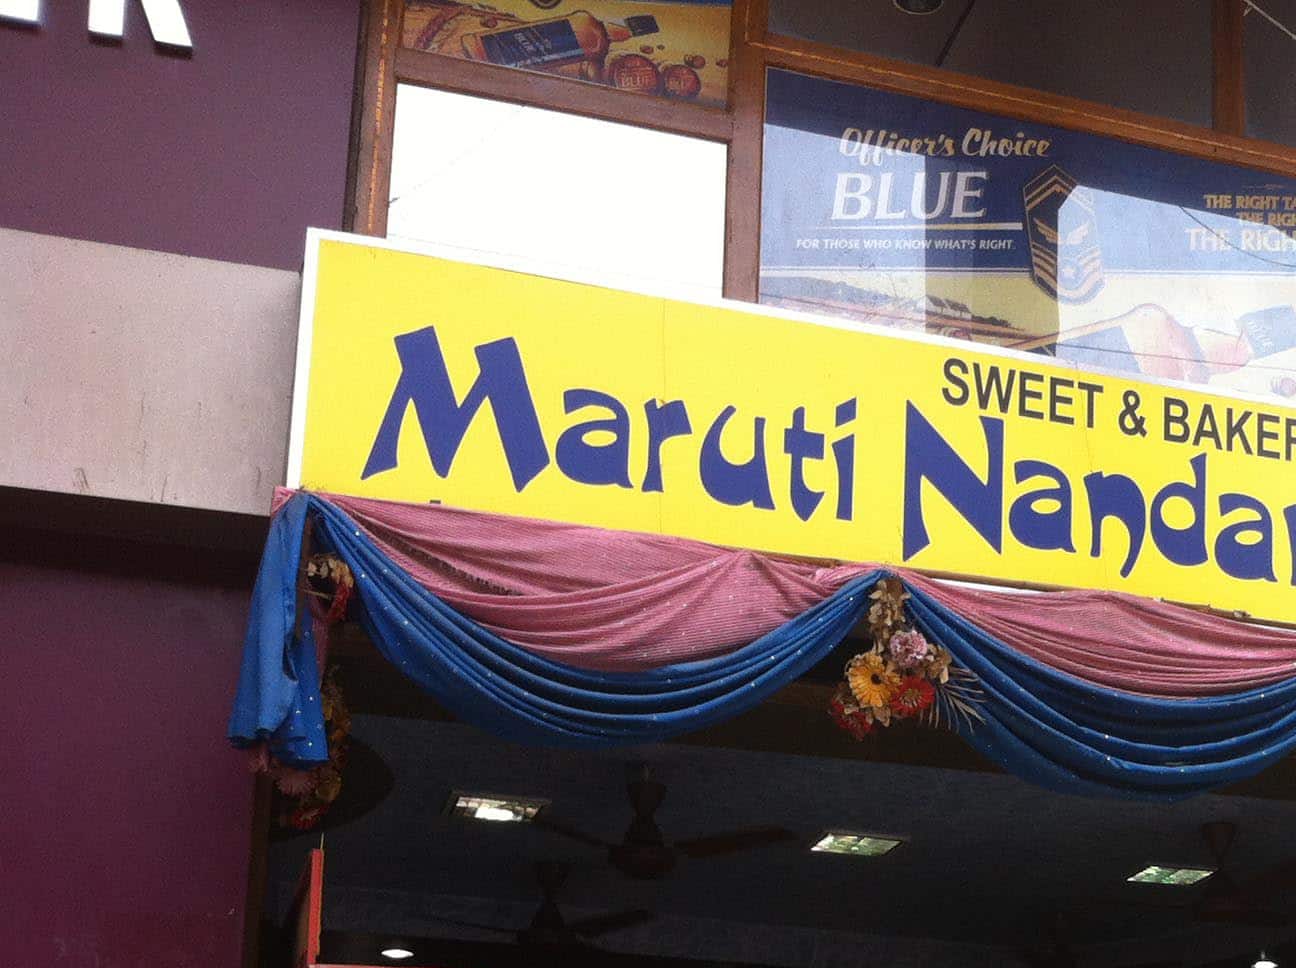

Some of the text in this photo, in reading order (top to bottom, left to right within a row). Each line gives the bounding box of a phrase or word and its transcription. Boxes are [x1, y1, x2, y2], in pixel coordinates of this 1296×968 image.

[839, 127, 1051, 166] Officer's Choice
[830, 171, 988, 220] BLUE
[1203, 194, 1233, 209] THE
[1235, 195, 1281, 209] RIGHT
[796, 239, 820, 249] FOR
[823, 239, 860, 249] THOSE
[863, 239, 891, 249] WHO
[895, 239, 932, 249] KNOW
[1184, 228, 1233, 252] THE
[941, 358, 1103, 429] SWEET
[1119, 391, 1148, 436] &
[361, 325, 857, 522] Maruti
